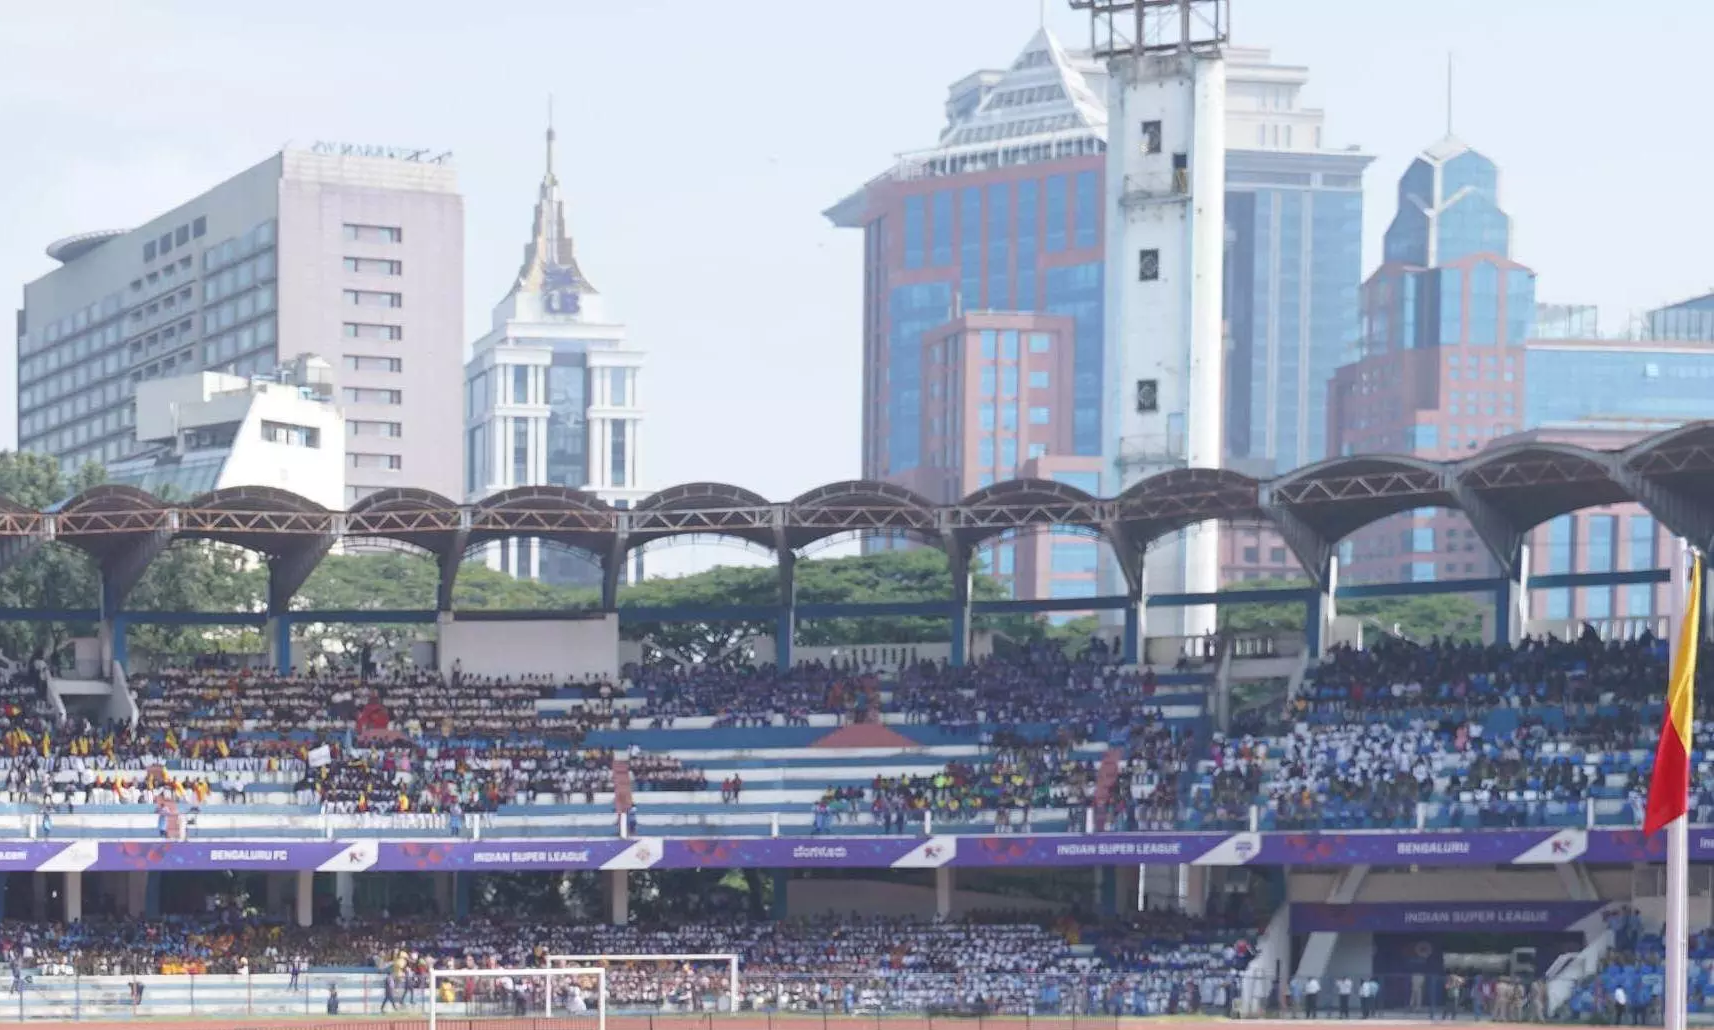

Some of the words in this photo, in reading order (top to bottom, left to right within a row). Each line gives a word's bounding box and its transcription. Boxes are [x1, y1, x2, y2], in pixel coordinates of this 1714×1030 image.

[1057, 844, 1096, 856] INDIAN
[1097, 843, 1135, 855] SUPER
[1136, 843, 1181, 855] LEAGUE
[1397, 841, 1470, 855] BENGALURU
[210, 849, 272, 861] BENGALURU
[474, 851, 511, 863] INDIAN
[511, 851, 546, 863] SUPER
[547, 851, 588, 862] LEAGUE
[1405, 911, 1450, 924] INDIAN
[1452, 911, 1496, 923] SUPER
[1497, 910, 1548, 923] LEAGUE
